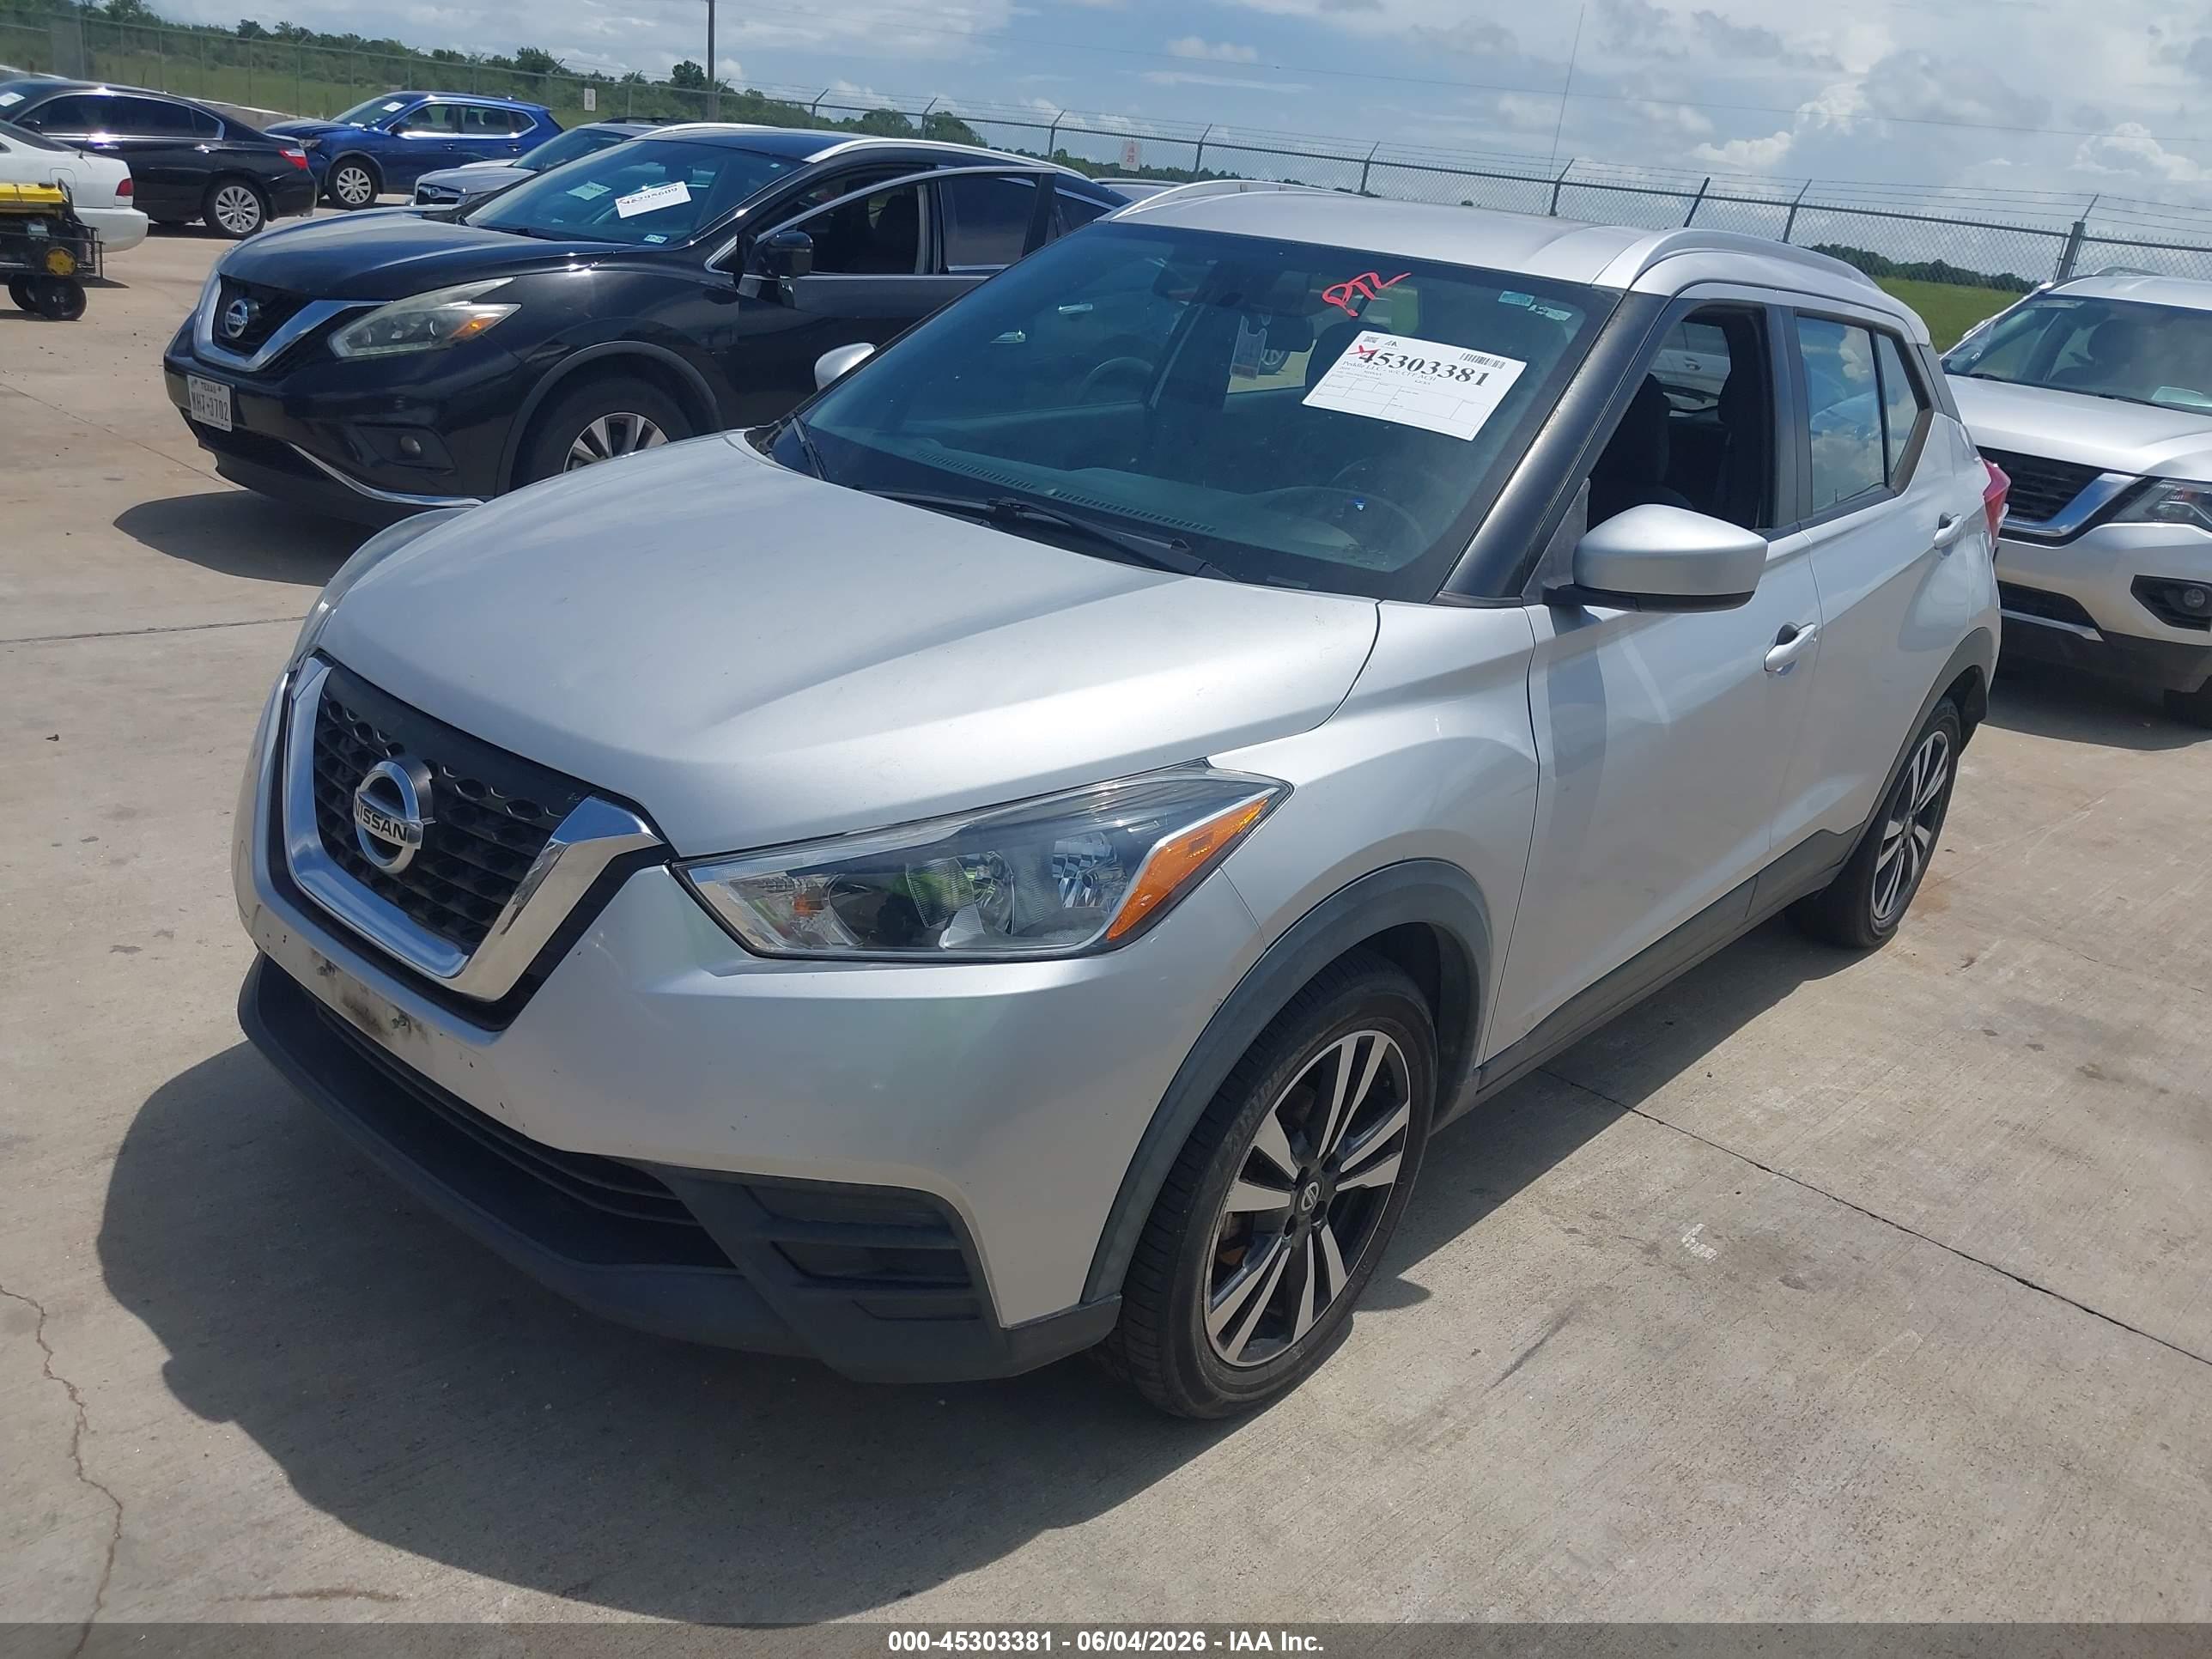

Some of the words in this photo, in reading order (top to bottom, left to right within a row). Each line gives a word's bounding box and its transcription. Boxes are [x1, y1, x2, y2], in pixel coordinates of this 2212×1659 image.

[1358, 348, 1491, 386] 45303381
[200, 381, 217, 394] TEXAS
[355, 795, 408, 842] NISSAN
